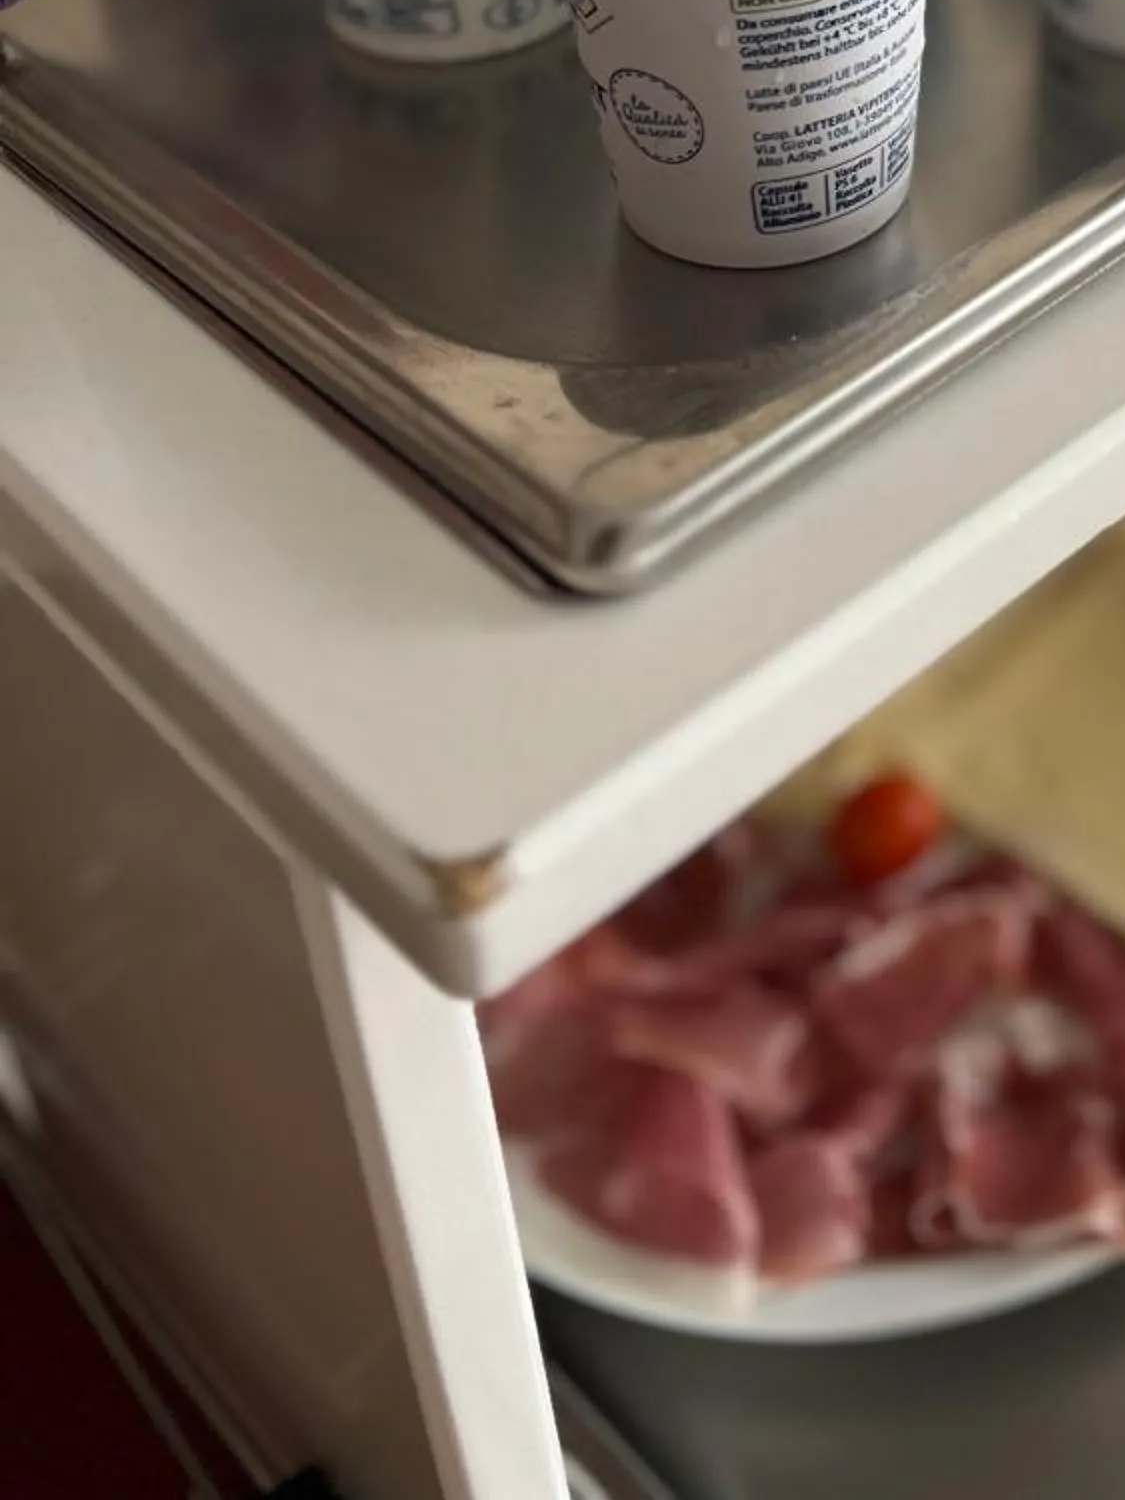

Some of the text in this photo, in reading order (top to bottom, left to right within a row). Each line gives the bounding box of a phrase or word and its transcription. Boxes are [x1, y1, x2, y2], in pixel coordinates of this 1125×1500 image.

[736, 18, 757, 31] Da
[759, 4, 837, 29] consumare
[741, 51, 822, 72] mindestens
[794, 108, 857, 137] LATTERIA
[754, 143, 777, 156] Via
